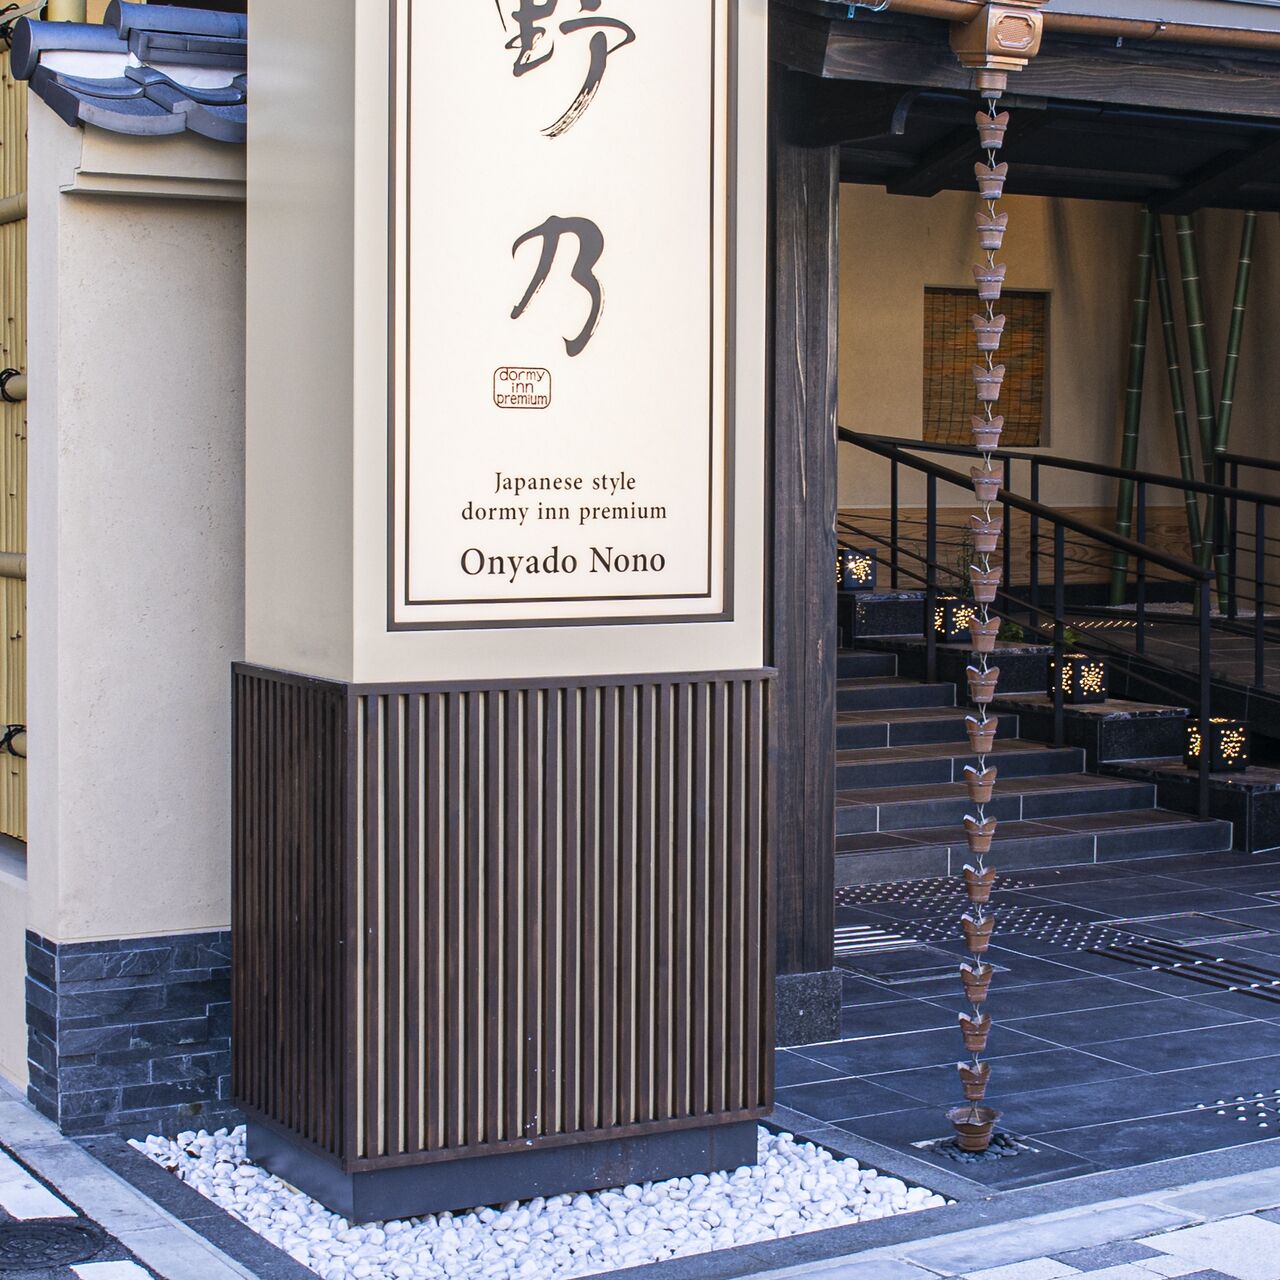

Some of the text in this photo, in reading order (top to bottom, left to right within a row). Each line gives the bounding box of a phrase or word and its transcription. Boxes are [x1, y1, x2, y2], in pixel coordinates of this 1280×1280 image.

[499, 368, 546, 382] dormy
[511, 382, 534, 393] inn
[496, 393, 548, 406] premium
[494, 471, 636, 496] Japanese style
[461, 500, 667, 526] dormy inn premium
[460, 545, 666, 584] Onyado Nono
